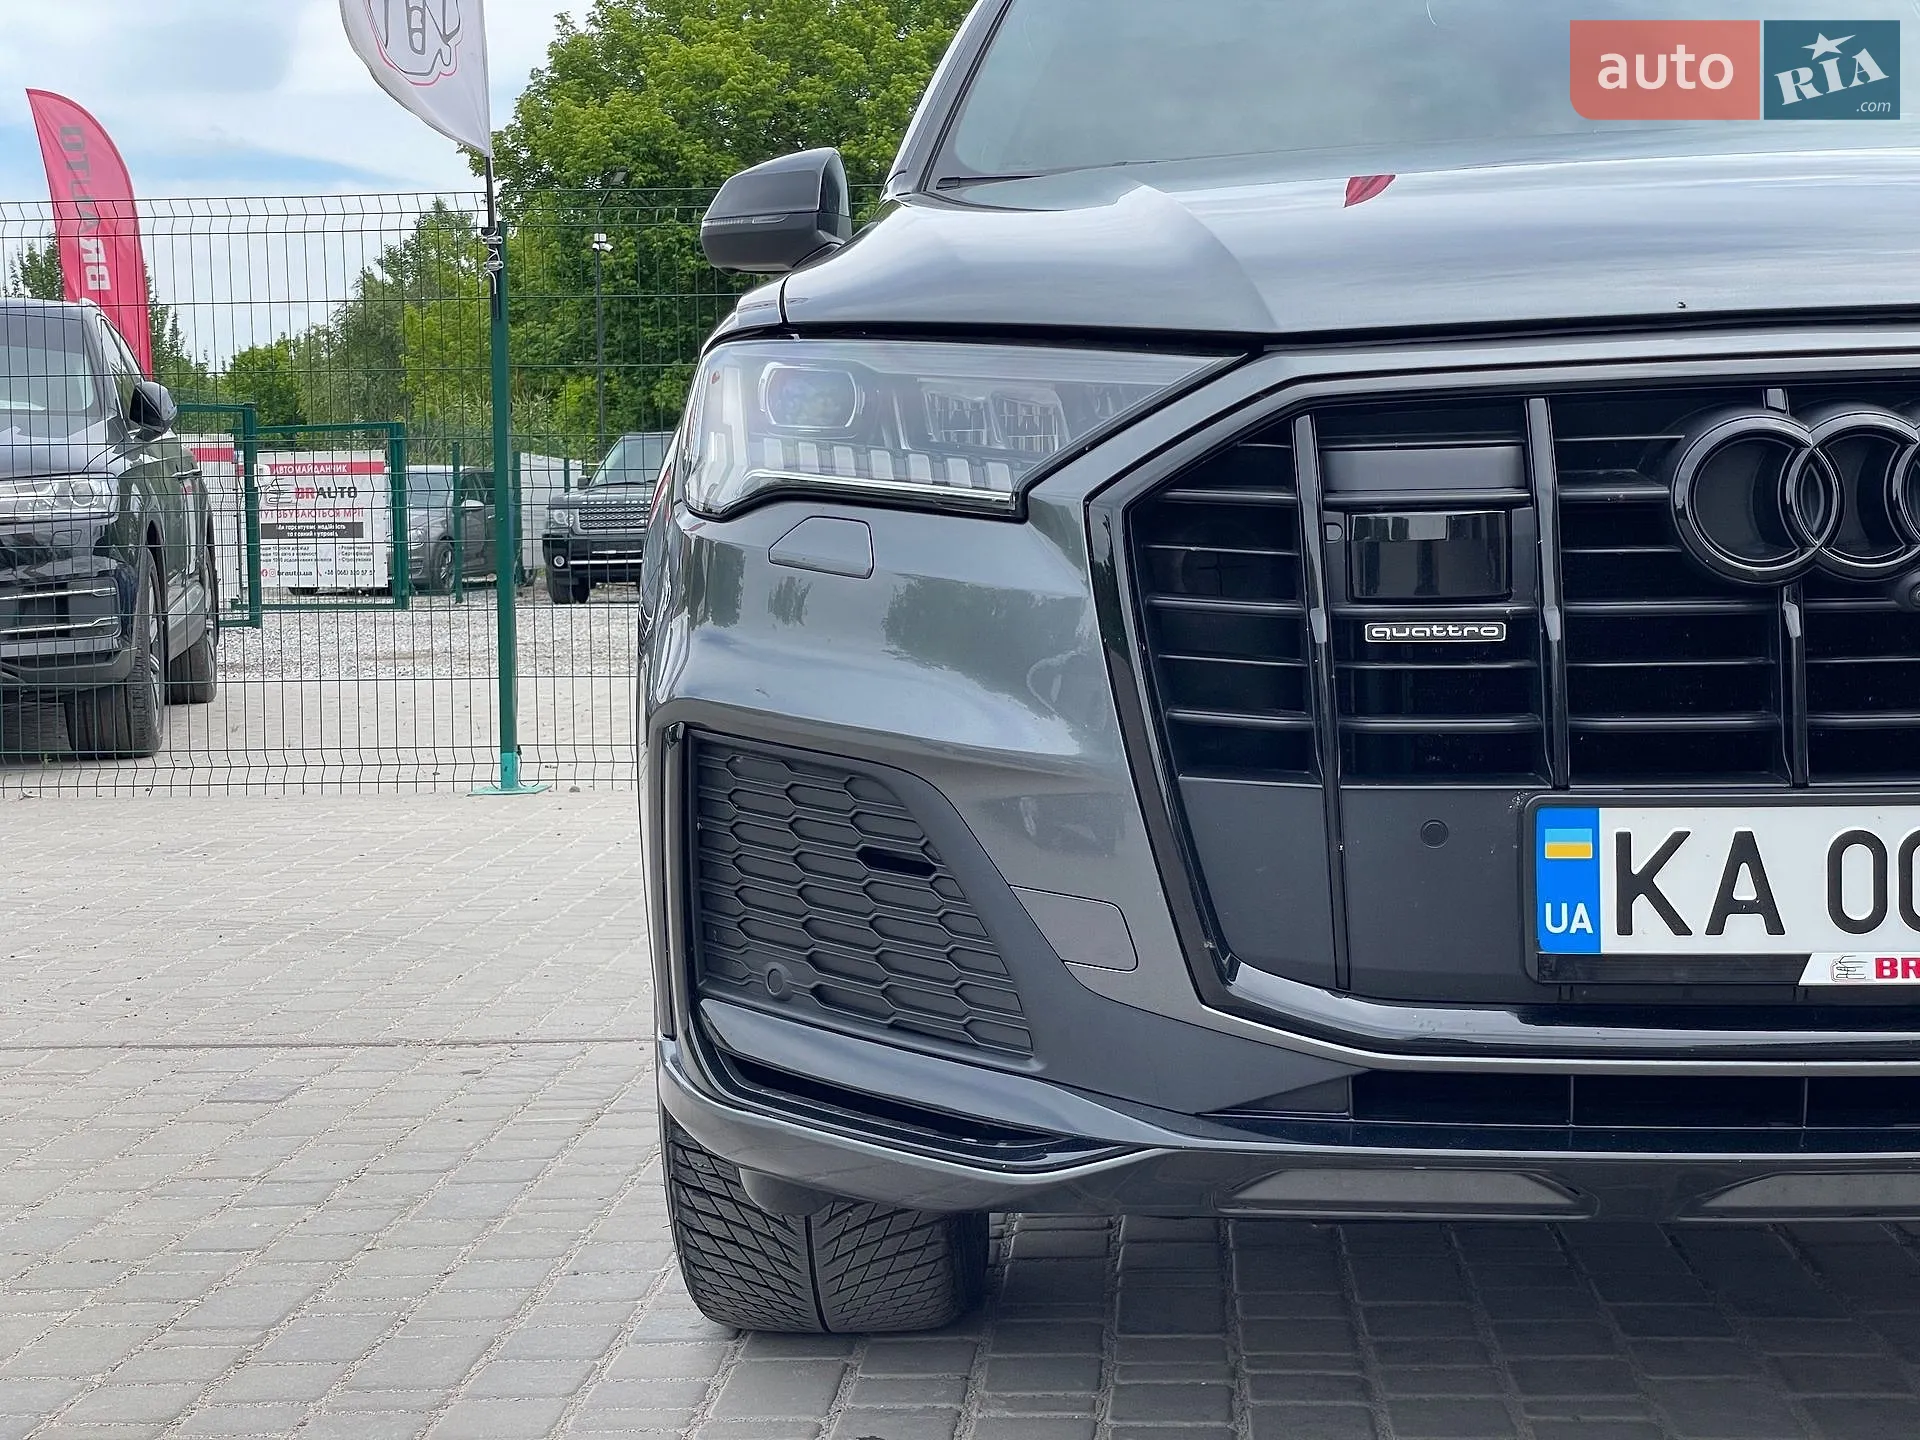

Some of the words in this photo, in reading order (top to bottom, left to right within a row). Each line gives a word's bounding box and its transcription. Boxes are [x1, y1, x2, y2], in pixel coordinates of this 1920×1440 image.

[1370, 624, 1501, 640] quattro
[1615, 830, 1786, 936] KA
[1545, 903, 1593, 934] UA
[1875, 957, 1920, 979] BR
